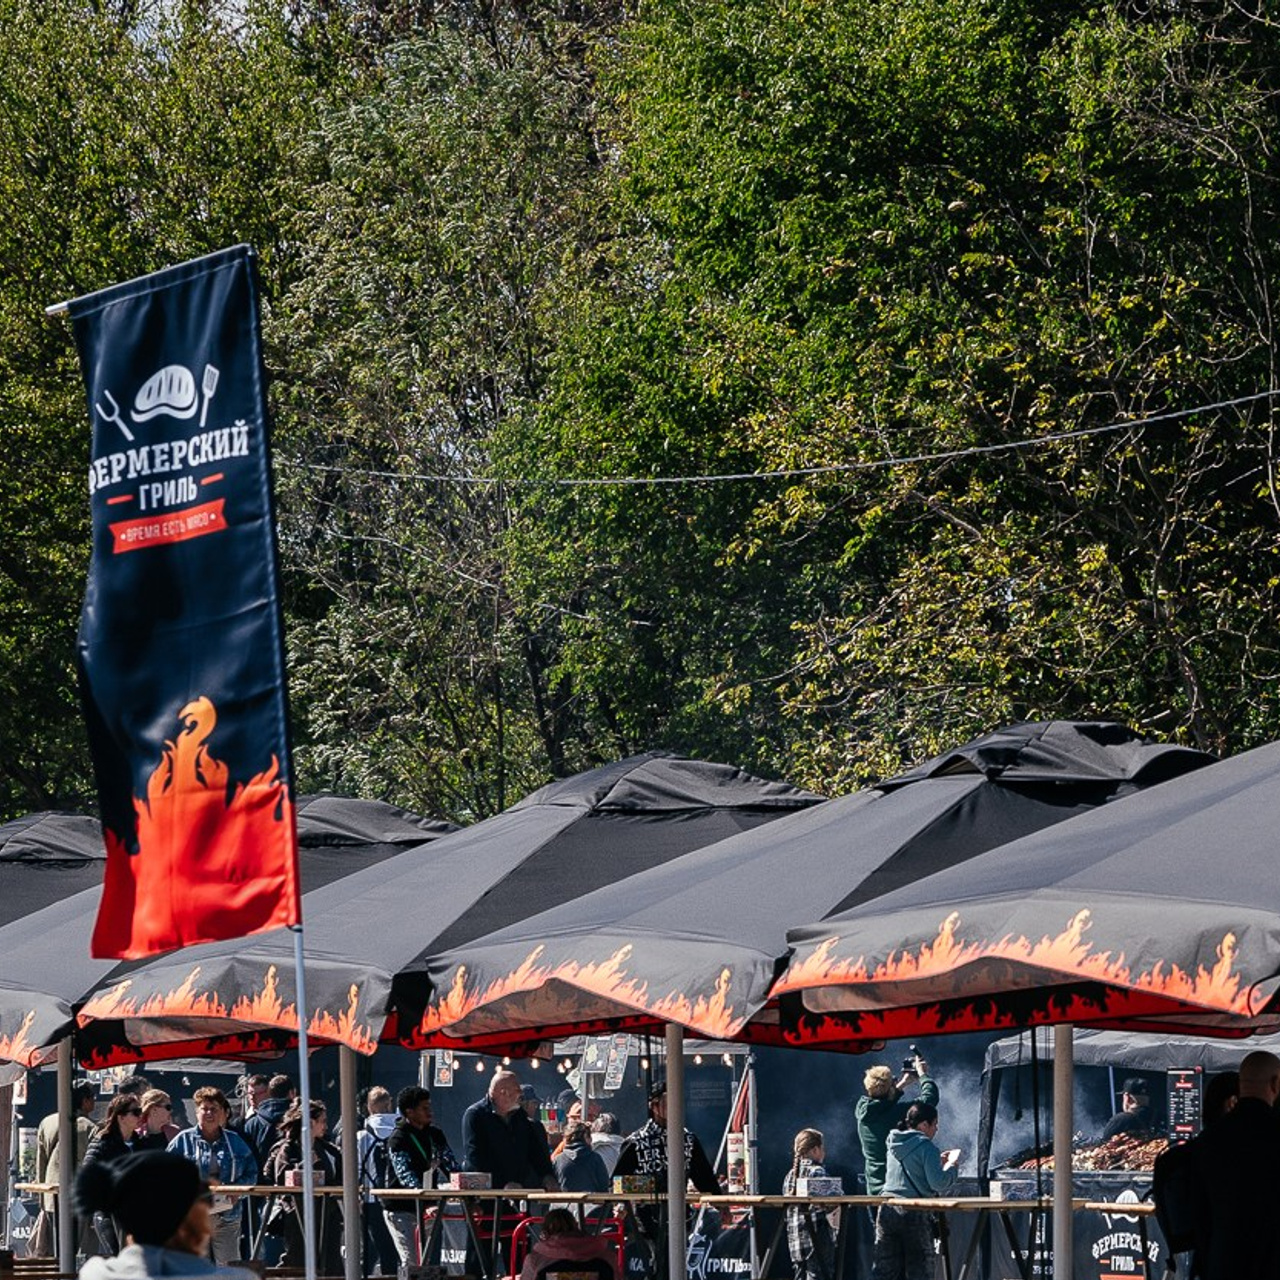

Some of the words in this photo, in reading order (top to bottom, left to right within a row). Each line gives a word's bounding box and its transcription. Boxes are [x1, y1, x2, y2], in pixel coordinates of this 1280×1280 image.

[139, 475, 198, 510] ГРИЛЬ
[126, 524, 160, 543] ВРЕМЯ
[162, 519, 186, 536] ЕСТЬ
[1110, 1255, 1135, 1272] ГРИЛЬ
